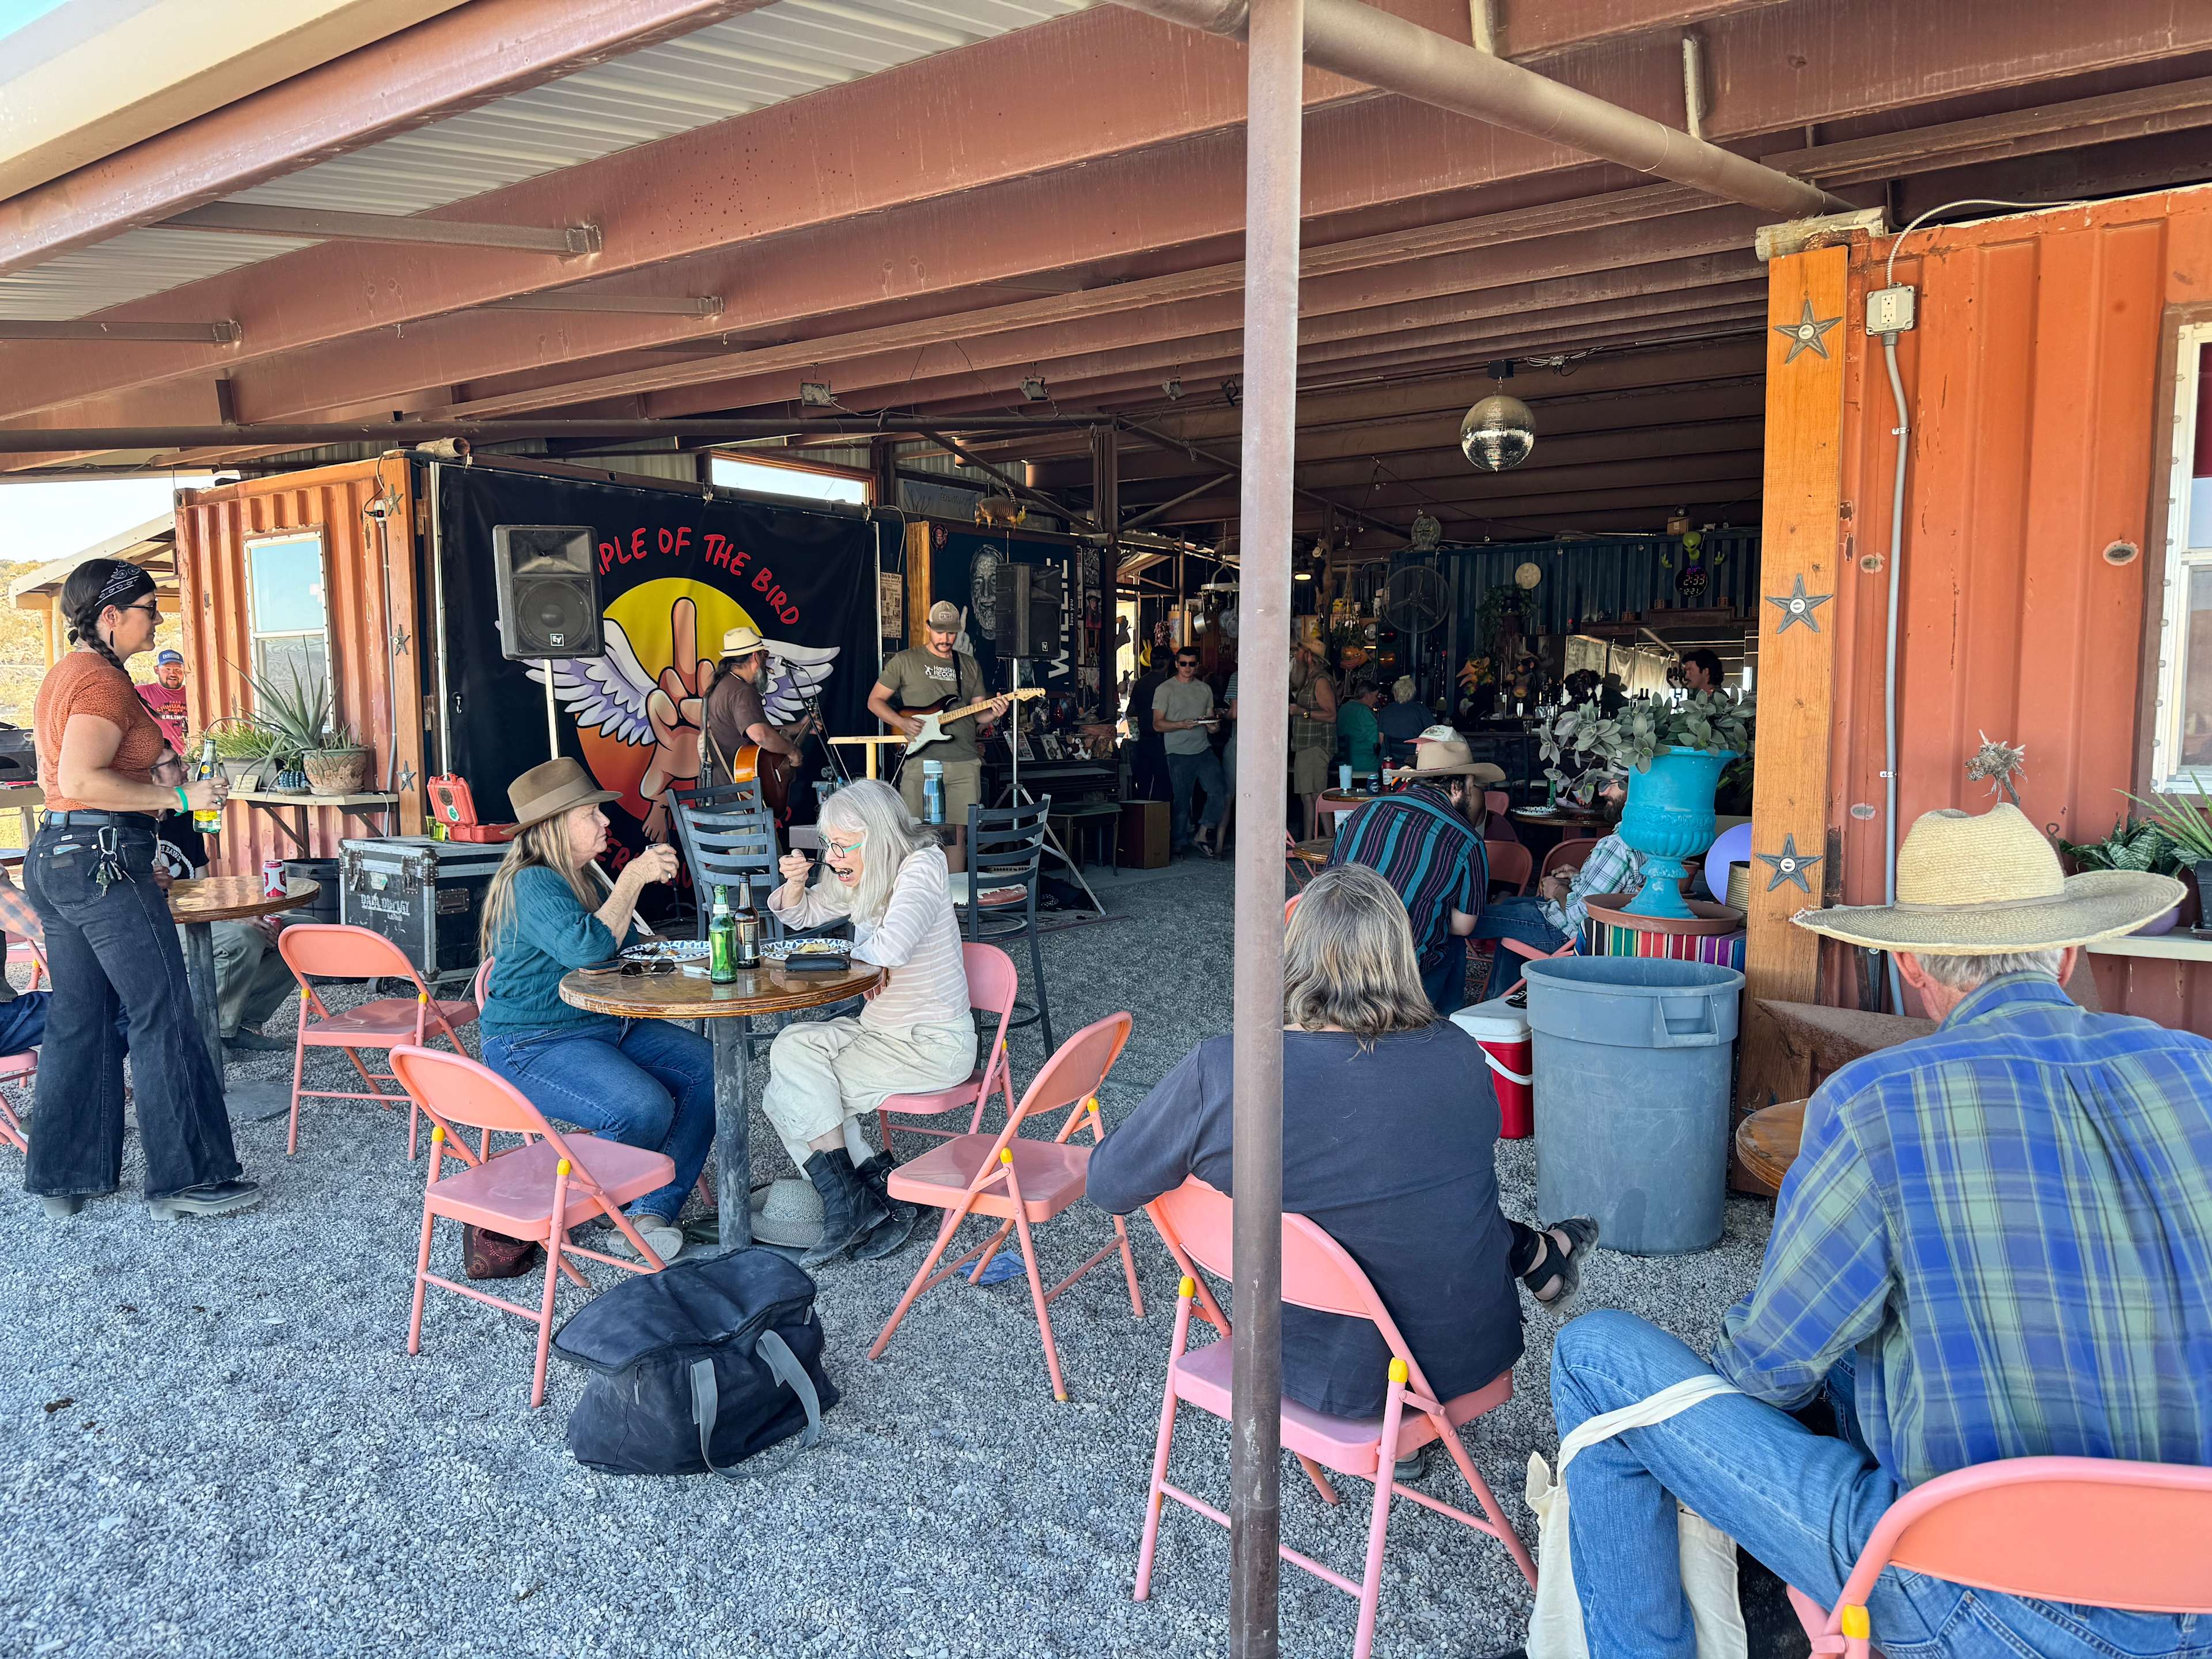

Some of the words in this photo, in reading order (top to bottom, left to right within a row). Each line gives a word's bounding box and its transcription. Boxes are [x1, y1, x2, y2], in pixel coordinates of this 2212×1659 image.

[599, 527, 647, 575] PLE
[658, 527, 691, 556] OF
[703, 534, 751, 575] THE
[752, 567, 799, 624] BIRD
